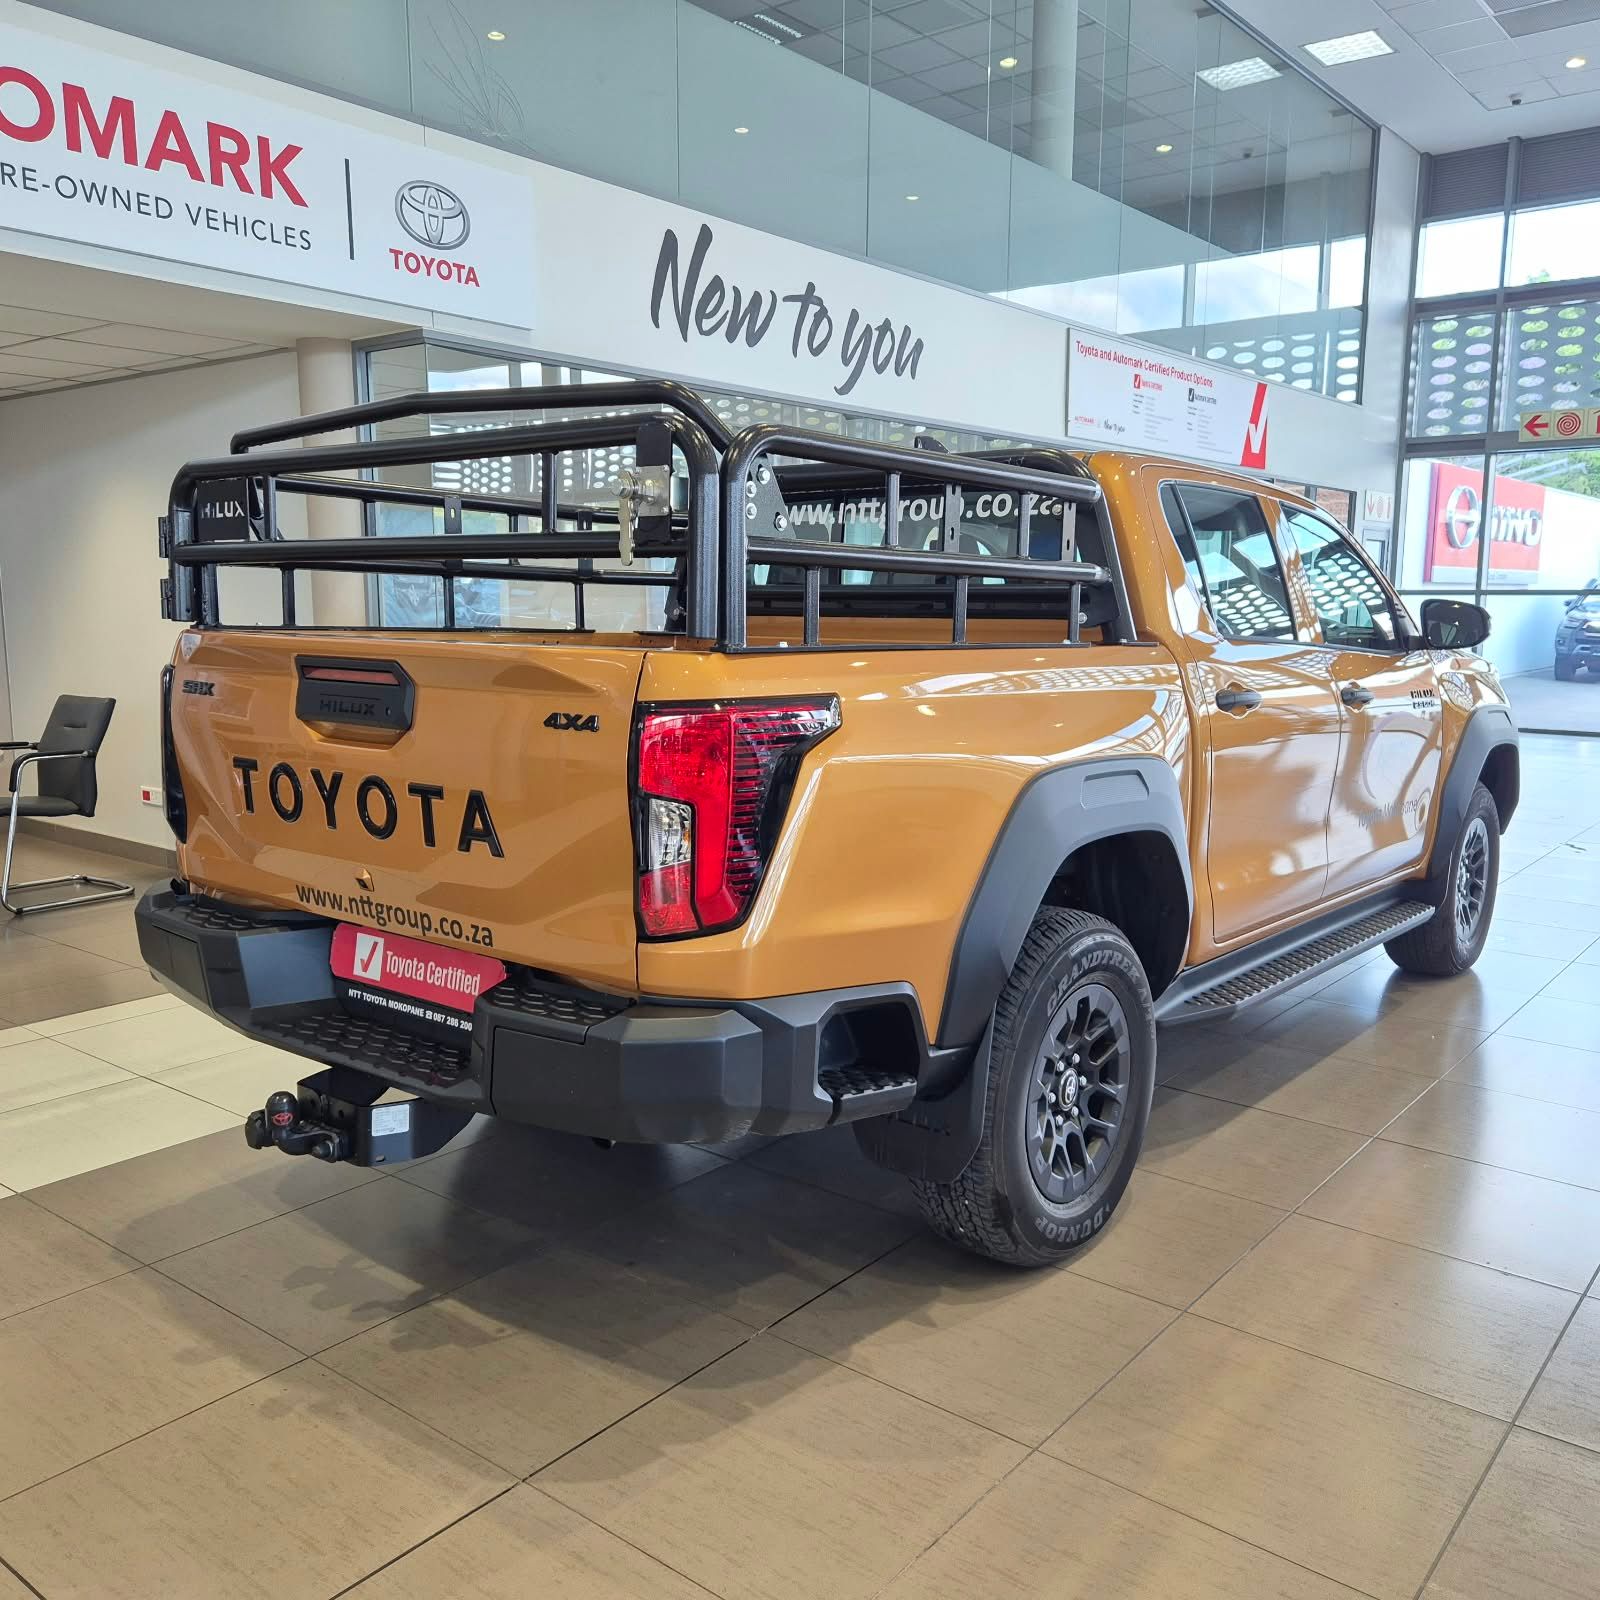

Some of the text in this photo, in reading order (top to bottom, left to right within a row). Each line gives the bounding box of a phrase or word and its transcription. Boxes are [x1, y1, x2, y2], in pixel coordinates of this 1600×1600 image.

[185, 206, 312, 250] VEHICLES
[389, 248, 480, 287] TOYOTA
[651, 223, 925, 396] New to you
[1075, 341, 1213, 388] Toyota and Automark Certified Product Options
[201, 500, 246, 519] HILUX
[320, 699, 376, 716] HILUX
[232, 756, 505, 859] TOYOTA
[295, 884, 494, 948] www.nttgroup.co.za
[386, 950, 481, 996] Toyota Certified
[348, 988, 362, 999] NTT
[362, 992, 387, 1007] TOYOTA
[388, 1000, 424, 1017] MOKOPANE
[1034, 1207, 1104, 1243] DUNLOP
